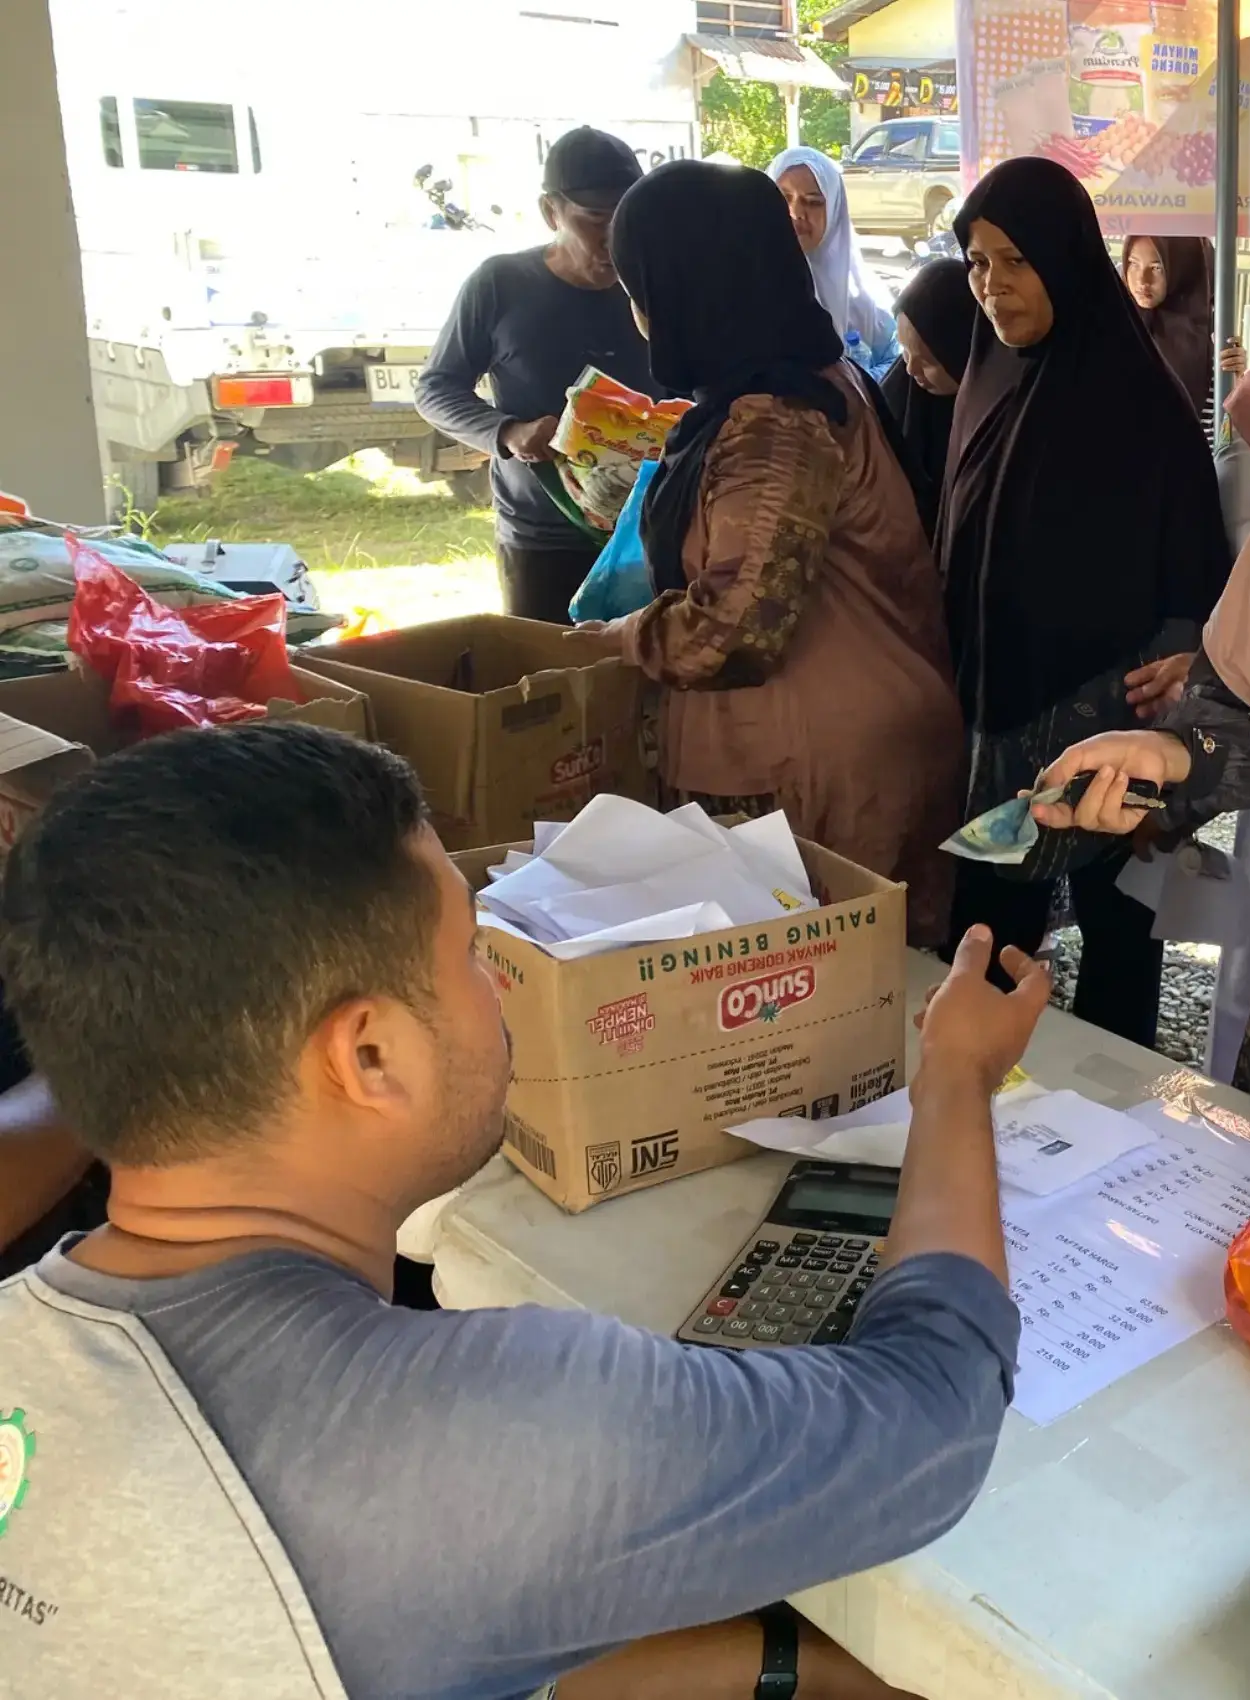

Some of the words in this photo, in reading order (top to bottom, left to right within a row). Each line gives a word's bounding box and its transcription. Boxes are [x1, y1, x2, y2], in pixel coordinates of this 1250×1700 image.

[374, 369, 399, 389] BL
[786, 906, 877, 944] PALING
[639, 933, 769, 981] BENING!!
[786, 939, 837, 964] MINYAK
[691, 964, 723, 985] BAIK
[726, 953, 784, 976] GORENG
[727, 969, 810, 1018] SunCo
[586, 1003, 648, 1034] NEMPEL
[851, 1077, 882, 1100] Refill
[631, 1135, 679, 1175] SNI
[760, 1287, 769, 1295] 4
[815, 1294, 823, 1302] 6
[717, 1300, 727, 1308] C
[775, 1307, 785, 1315] 2
[703, 1317, 712, 1325] 0
[730, 1320, 747, 1329] 00
[758, 1325, 778, 1334] 000
